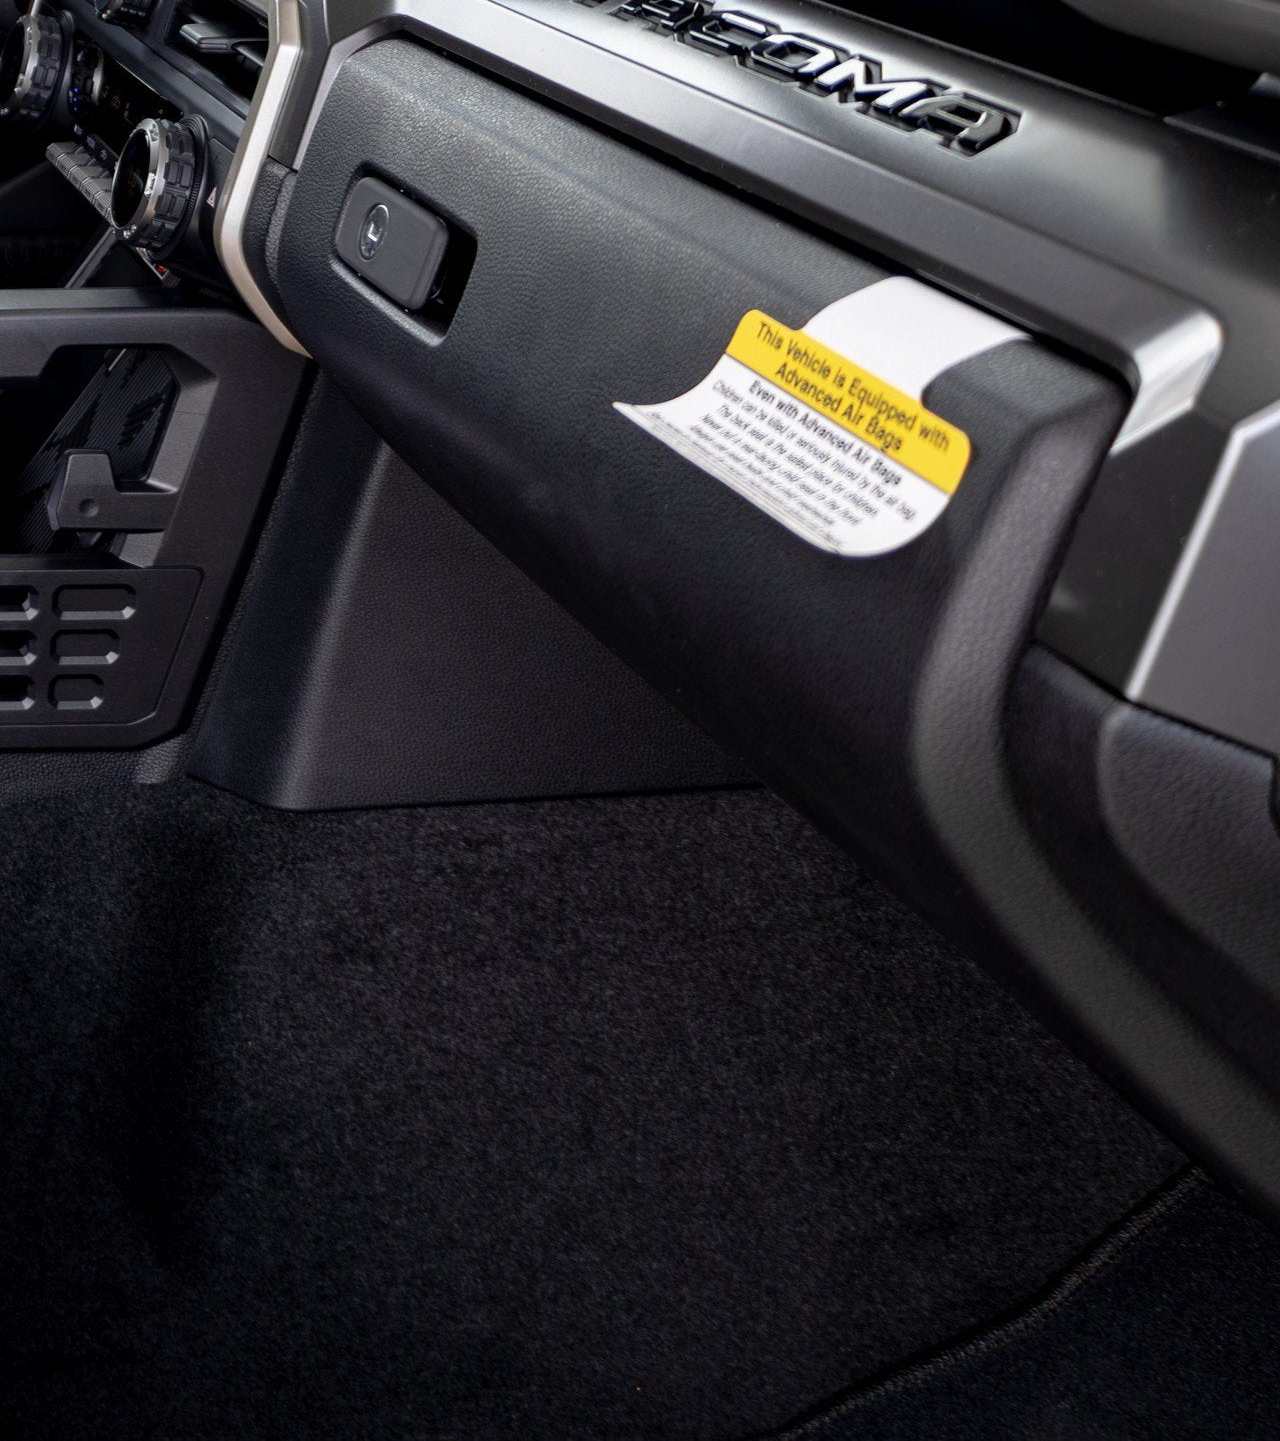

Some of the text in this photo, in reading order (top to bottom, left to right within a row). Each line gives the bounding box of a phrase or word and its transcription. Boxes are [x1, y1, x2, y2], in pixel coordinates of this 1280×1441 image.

[749, 380, 901, 485] Even with Advanced Air Bags
[756, 322, 950, 450] This Vehicle is Equipped with
[774, 362, 903, 453] Advanced Air Bags
